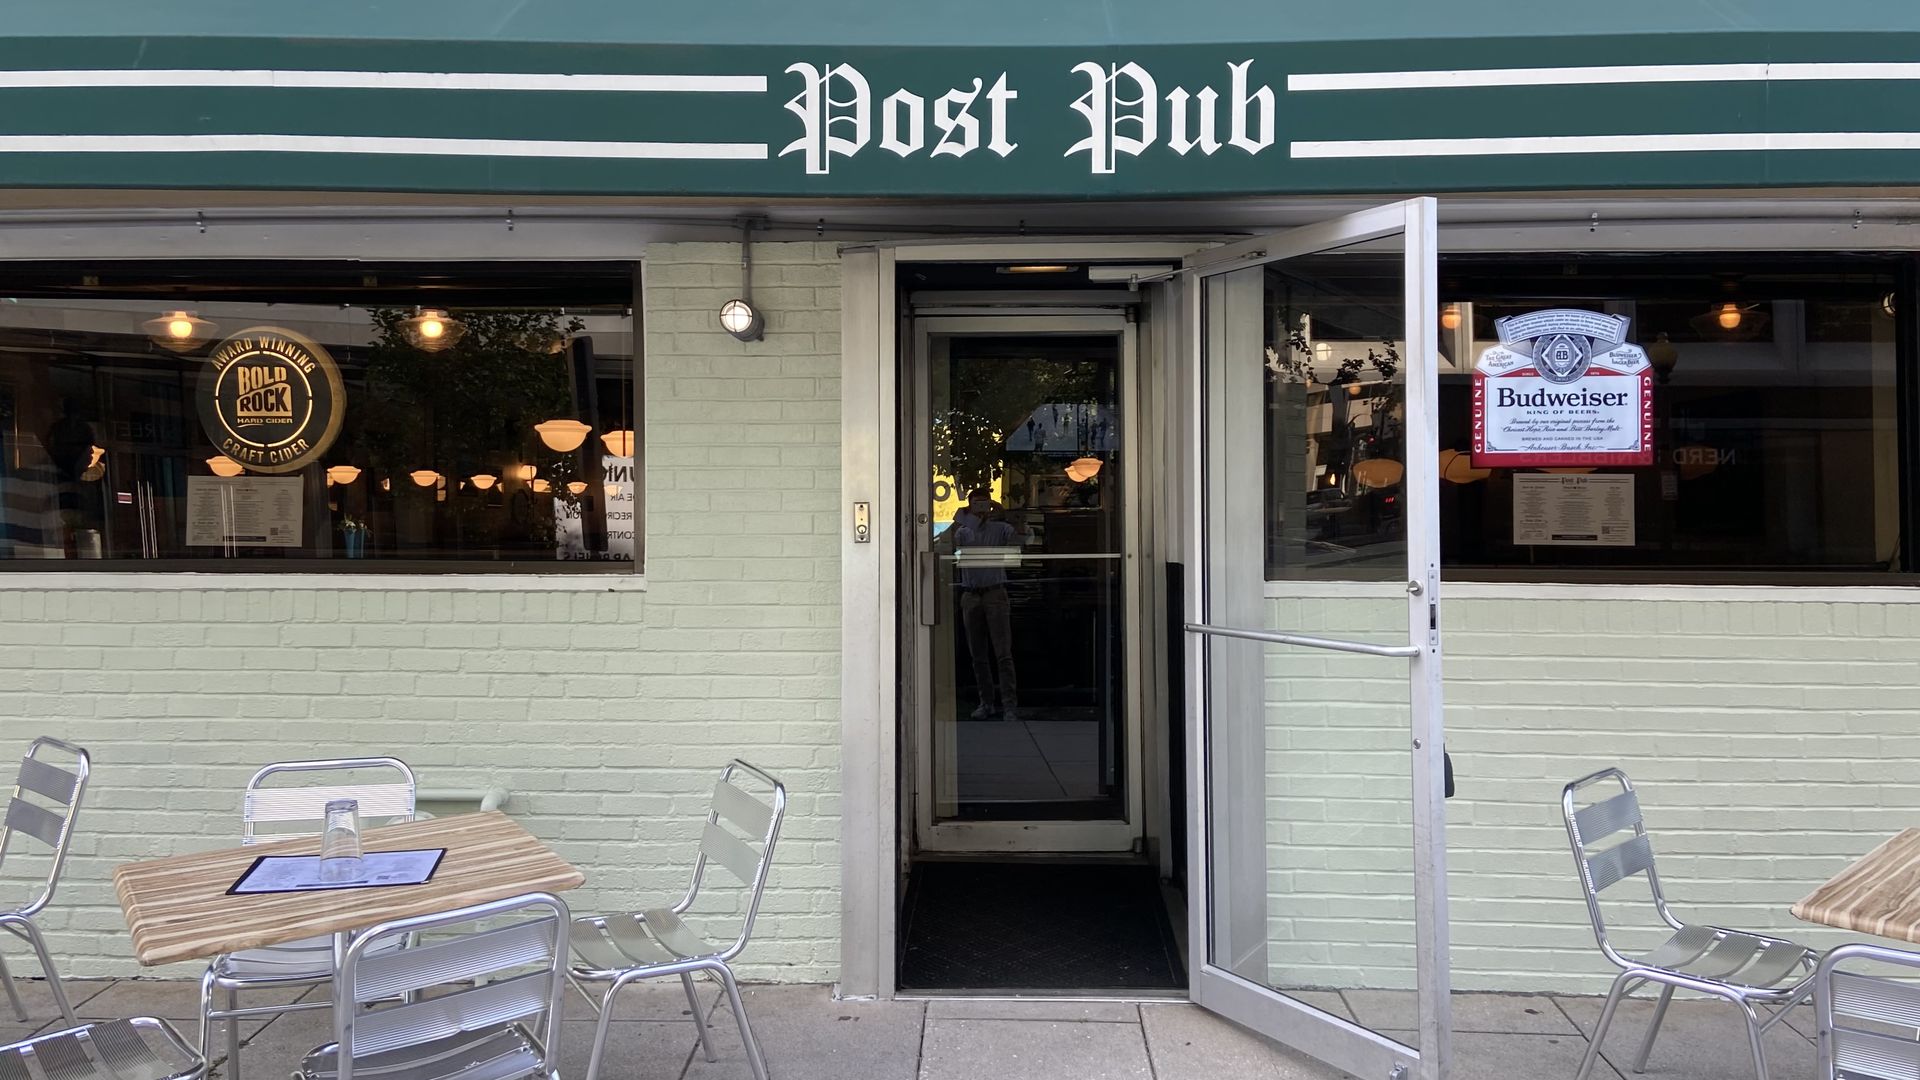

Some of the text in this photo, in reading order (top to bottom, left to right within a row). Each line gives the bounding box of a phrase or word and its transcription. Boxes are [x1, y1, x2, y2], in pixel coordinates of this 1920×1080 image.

[777, 58, 1277, 175] Post Pub
[211, 336, 317, 374] AWARD WINNING
[237, 366, 287, 396] BOLD
[1496, 387, 1628, 408] Budweiser
[240, 386, 290, 412] ROCK
[1474, 378, 1482, 453] GENUINE
[1644, 376, 1652, 452] GENUINE
[222, 438, 310, 463] CRAFT CIDER
